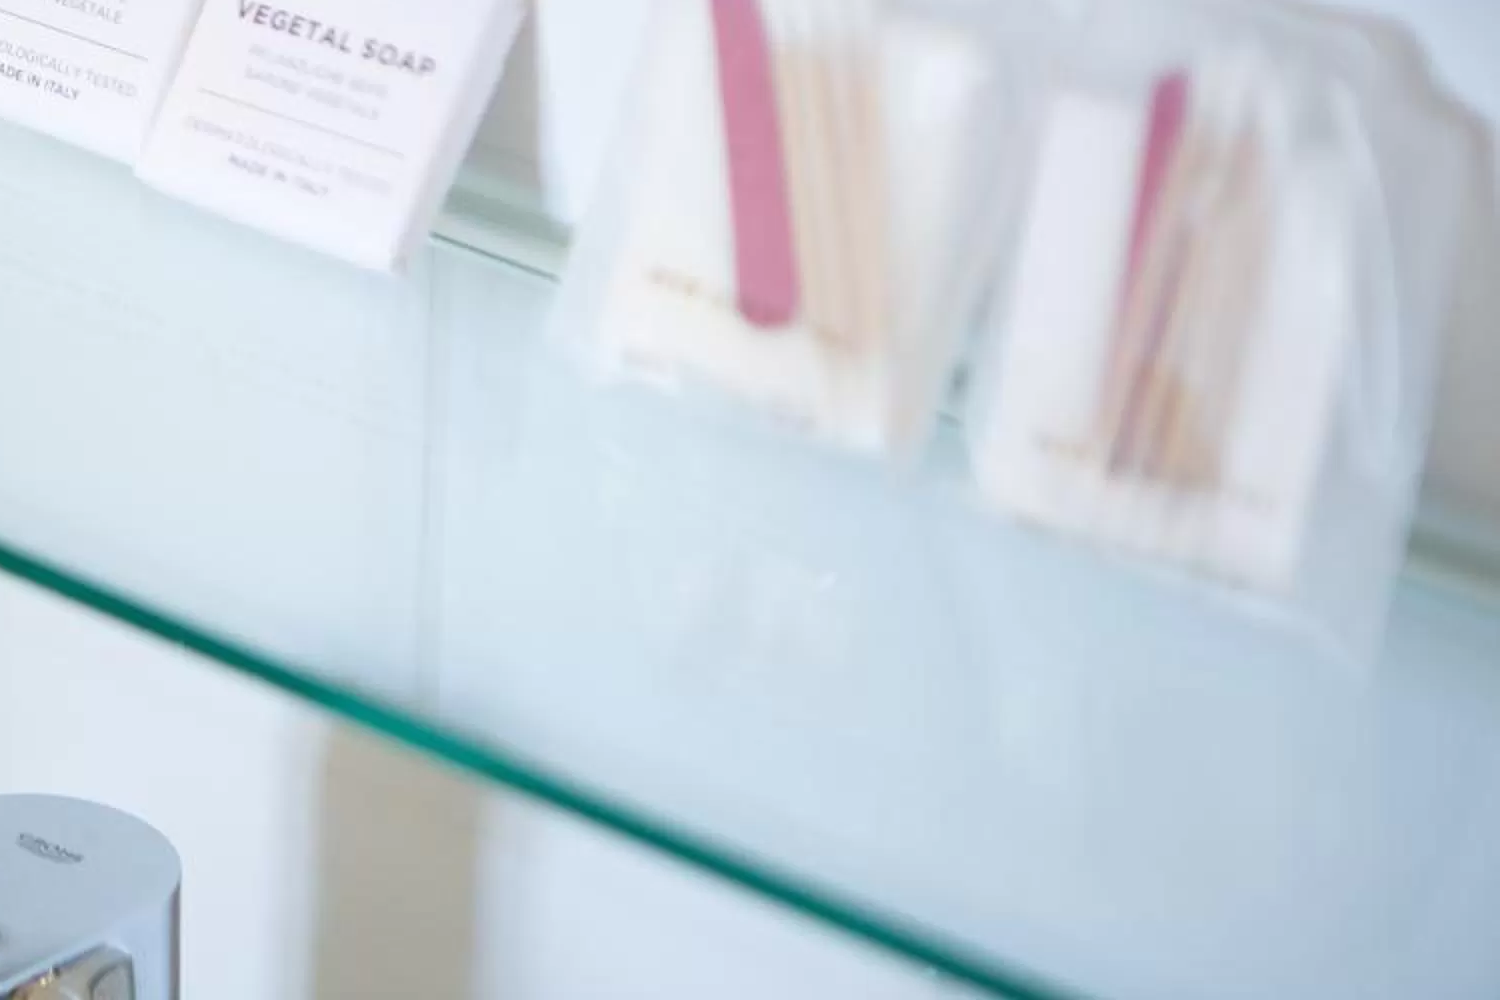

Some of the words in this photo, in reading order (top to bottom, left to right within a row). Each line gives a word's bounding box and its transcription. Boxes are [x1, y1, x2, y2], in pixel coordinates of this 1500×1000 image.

[361, 36, 438, 76] SOAP
[27, 71, 42, 88] IN
[44, 78, 81, 101] ITALY
